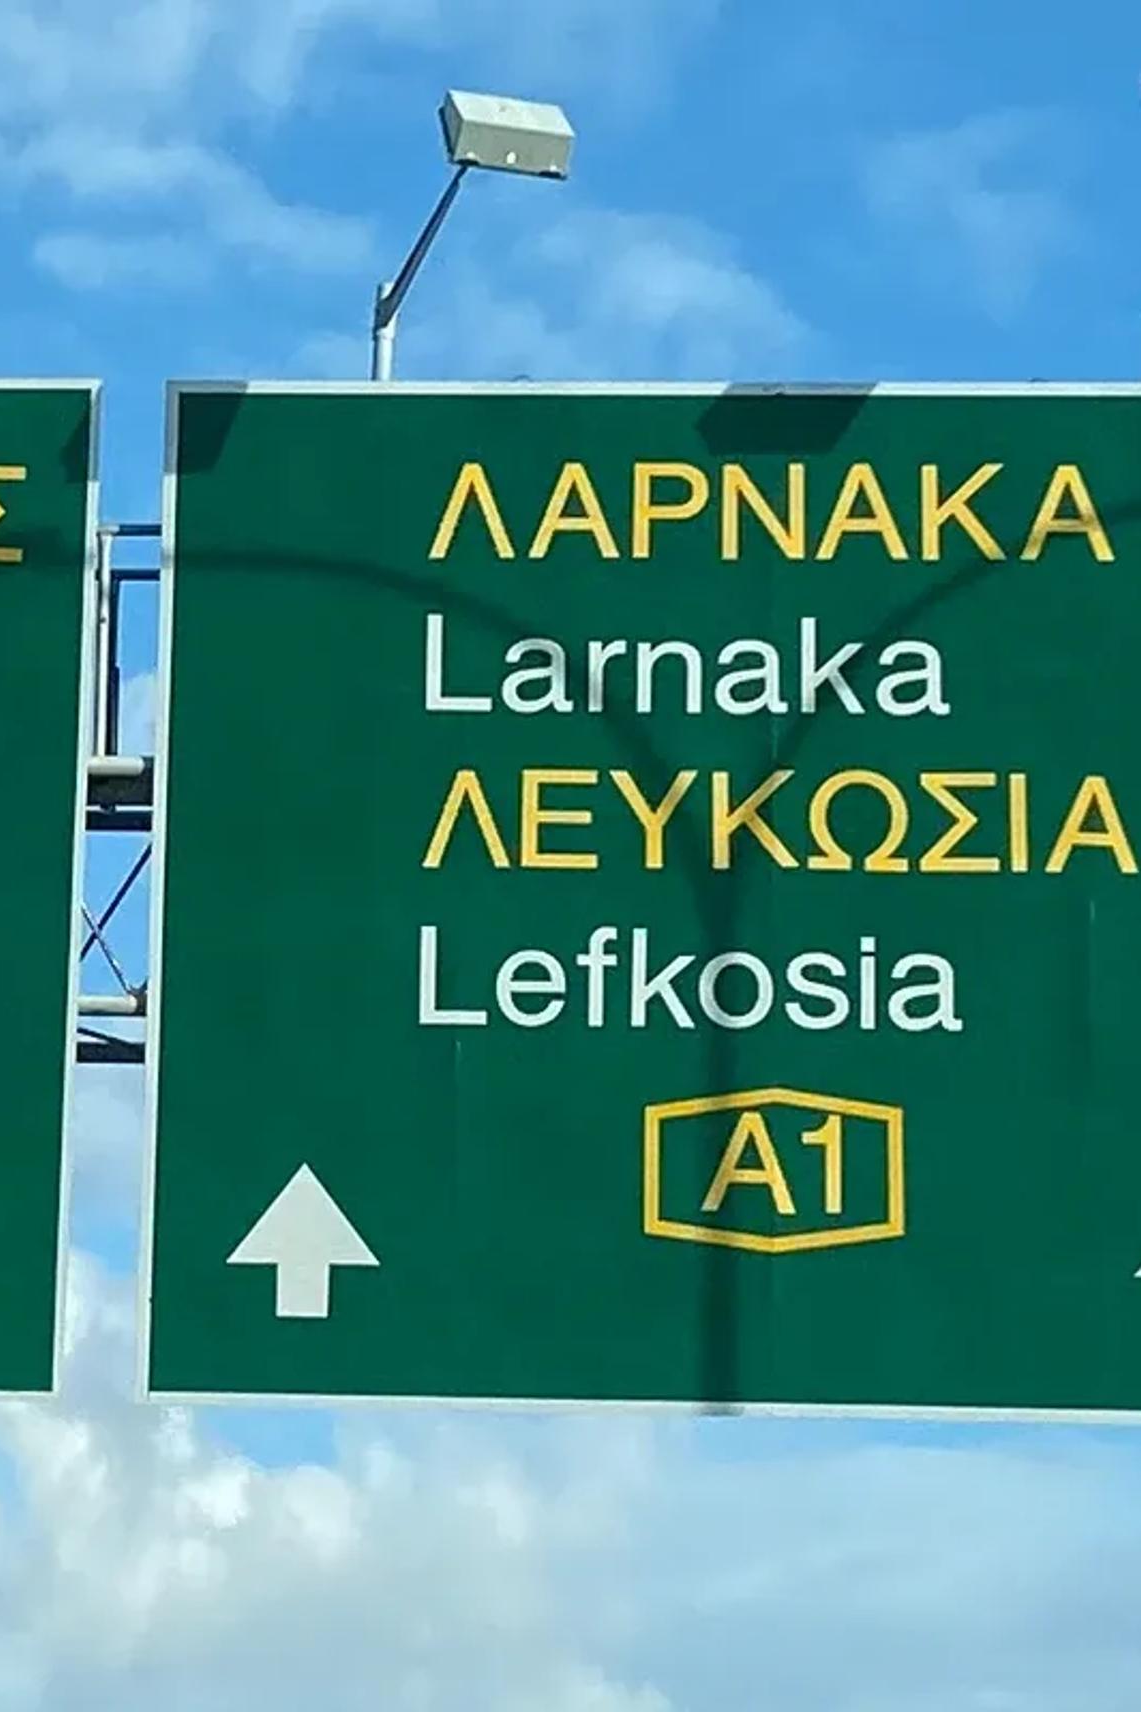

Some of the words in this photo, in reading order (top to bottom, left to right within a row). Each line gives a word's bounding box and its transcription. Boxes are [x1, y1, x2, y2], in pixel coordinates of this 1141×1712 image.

[428, 462, 1115, 562] ΛΑΡΝΑΚΑ
[425, 613, 951, 716] Larnaka
[422, 769, 1140, 874] ΛΕΥΚΩΣΙΑ
[419, 925, 963, 1032] Lefkosia
[701, 1111, 843, 1215] A1
